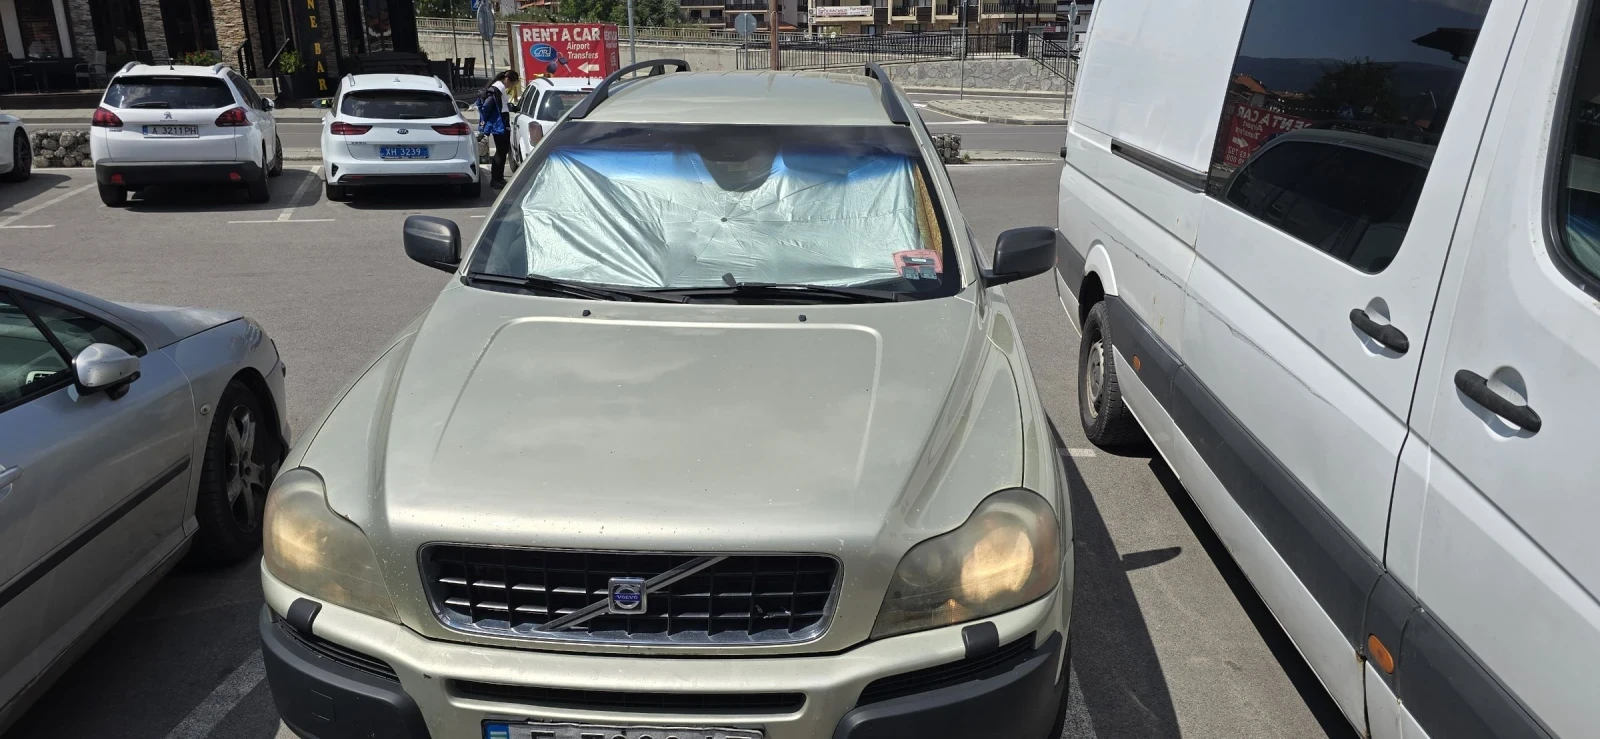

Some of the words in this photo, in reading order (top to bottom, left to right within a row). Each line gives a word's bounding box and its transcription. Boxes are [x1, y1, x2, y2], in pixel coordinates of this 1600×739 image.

[522, 28, 558, 42] RENT
[561, 28, 572, 41] A
[573, 28, 600, 41] CAR
[566, 42, 590, 50] Airport
[567, 52, 598, 60] Transfers
[314, 42, 328, 90] BAR
